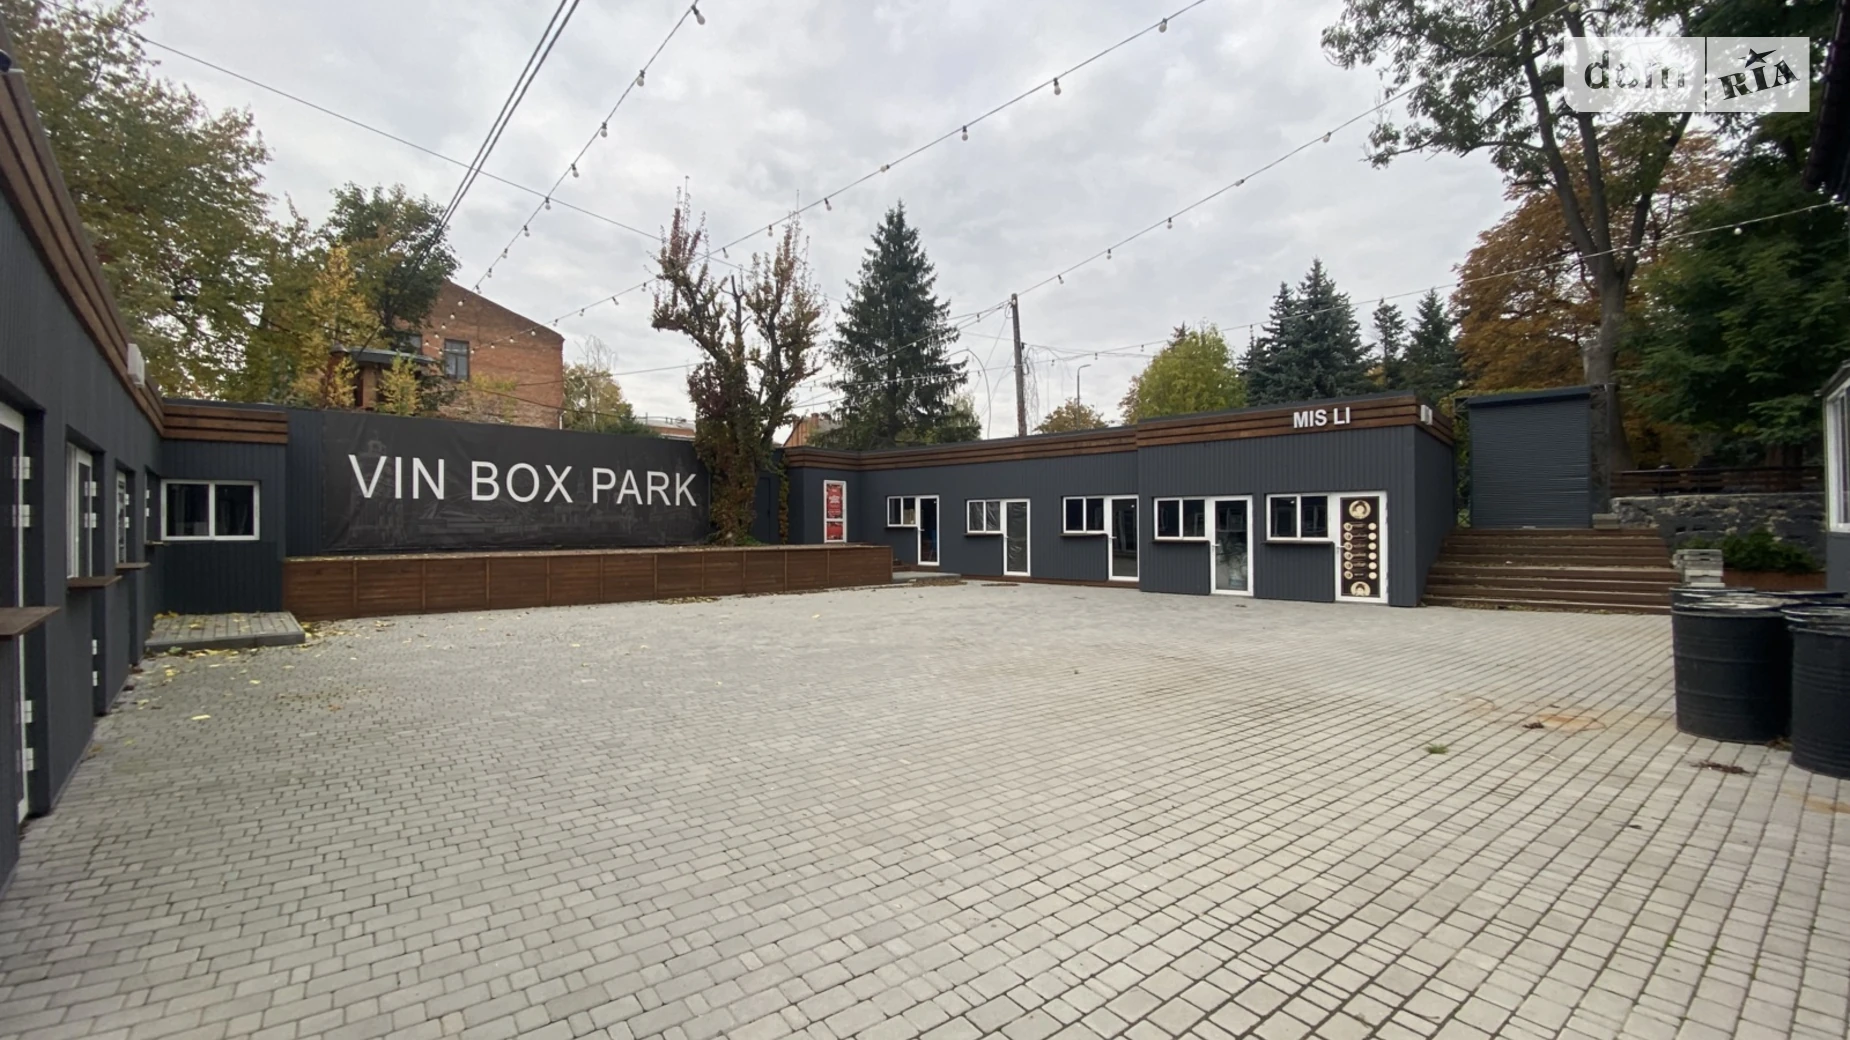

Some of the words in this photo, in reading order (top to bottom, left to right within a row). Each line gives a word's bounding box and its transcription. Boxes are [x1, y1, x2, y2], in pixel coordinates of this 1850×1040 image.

[1293, 409, 1328, 429] MIS
[1333, 406, 1351, 425] LI
[348, 454, 446, 500] VIN
[470, 460, 574, 504] BOX
[591, 466, 698, 507] PARK
